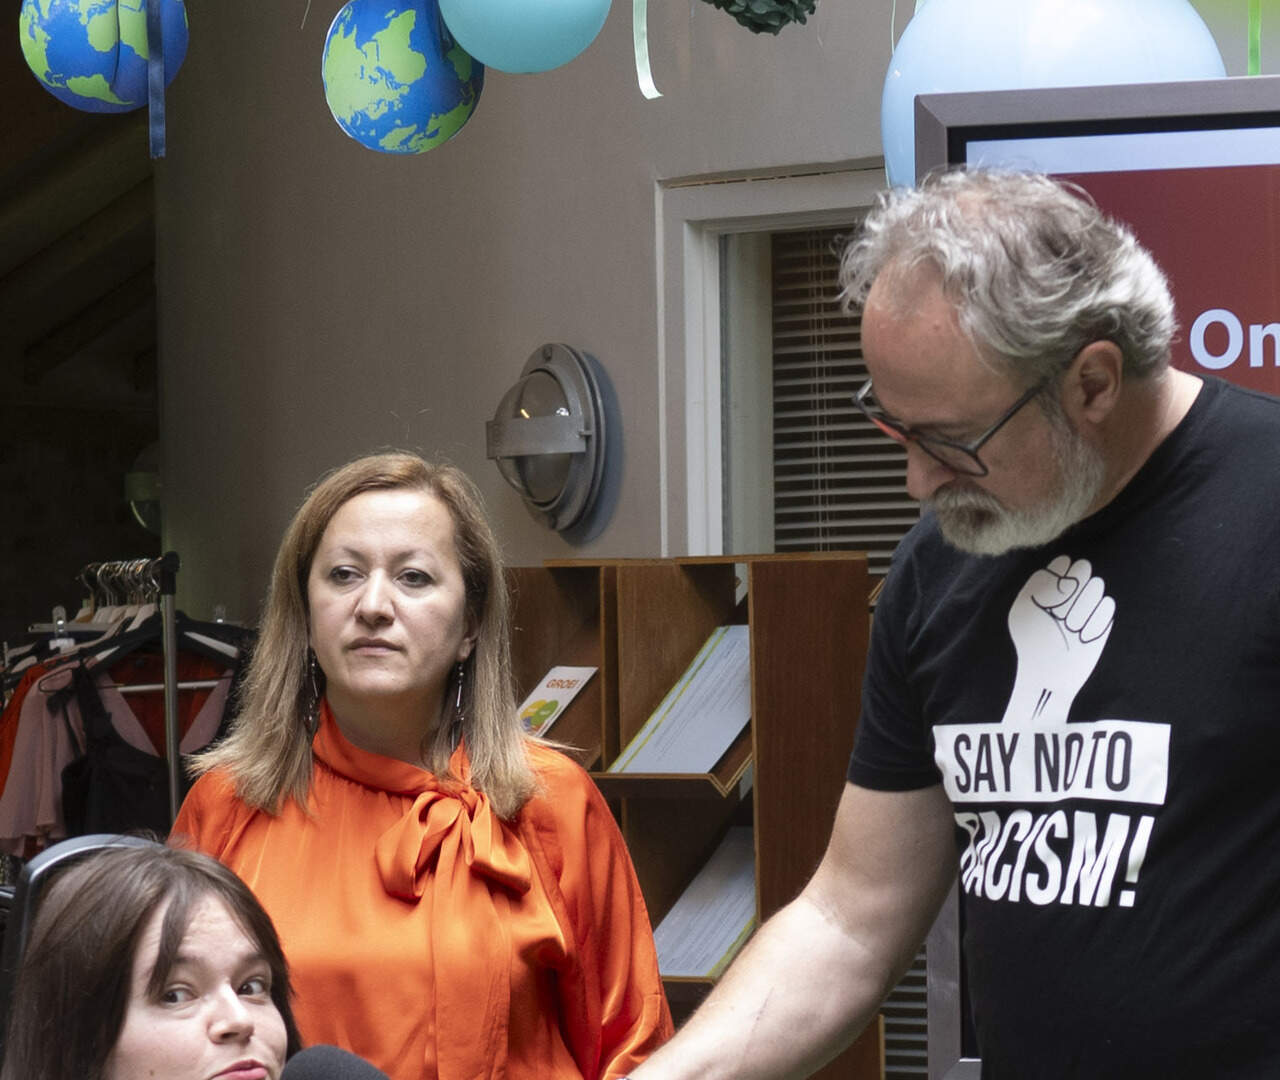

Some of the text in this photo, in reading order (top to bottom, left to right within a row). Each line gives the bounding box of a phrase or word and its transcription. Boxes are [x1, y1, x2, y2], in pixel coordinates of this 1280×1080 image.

[954, 730, 1133, 794] SAY NO TO
[953, 808, 1156, 908] RACISM!
